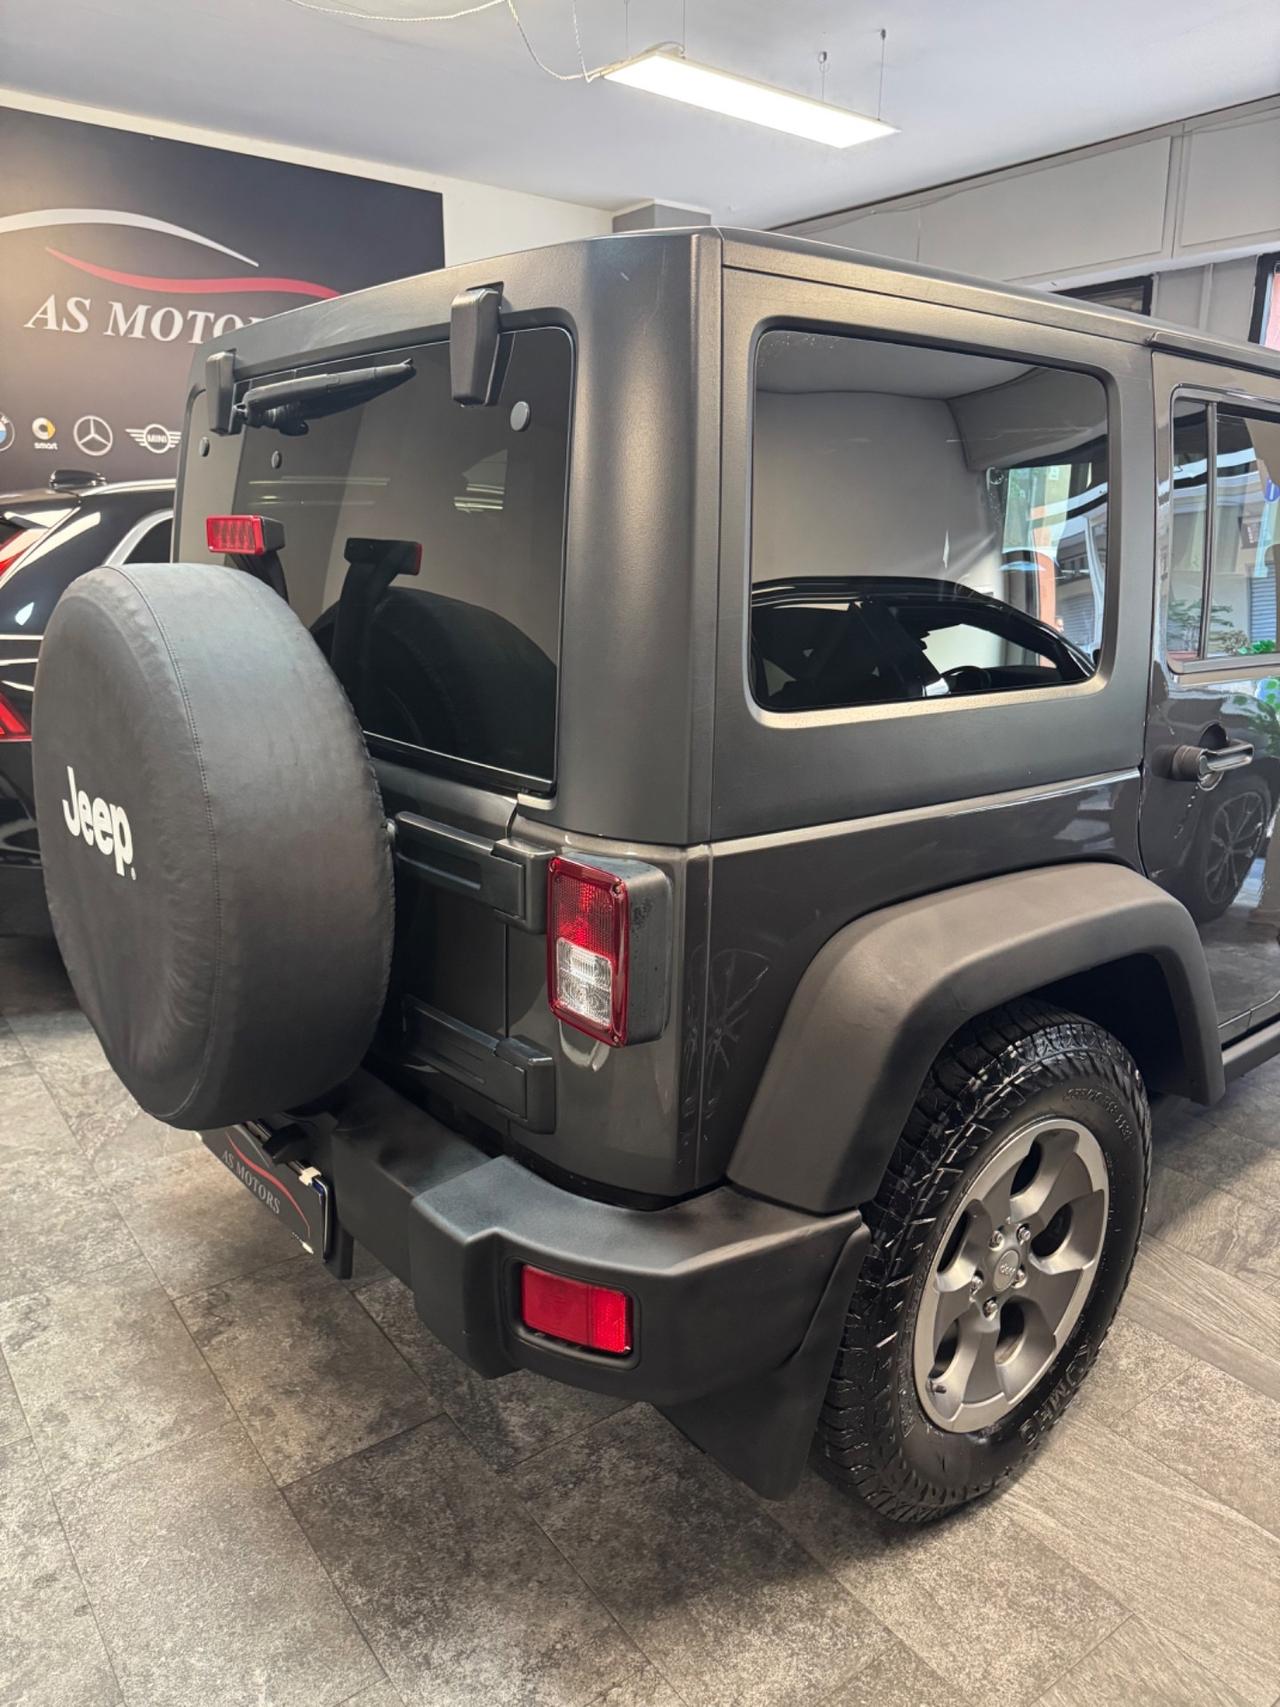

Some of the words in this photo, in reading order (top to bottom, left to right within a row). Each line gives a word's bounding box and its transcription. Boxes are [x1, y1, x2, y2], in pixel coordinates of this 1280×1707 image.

[23, 294, 92, 334] AS
[103, 301, 264, 345] MOTO
[34, 442, 58, 450] smart
[147, 433, 171, 444] MINI
[62, 765, 134, 877] Jeep
[221, 1150, 234, 1169] AS
[235, 1162, 281, 1215] MOTORS
